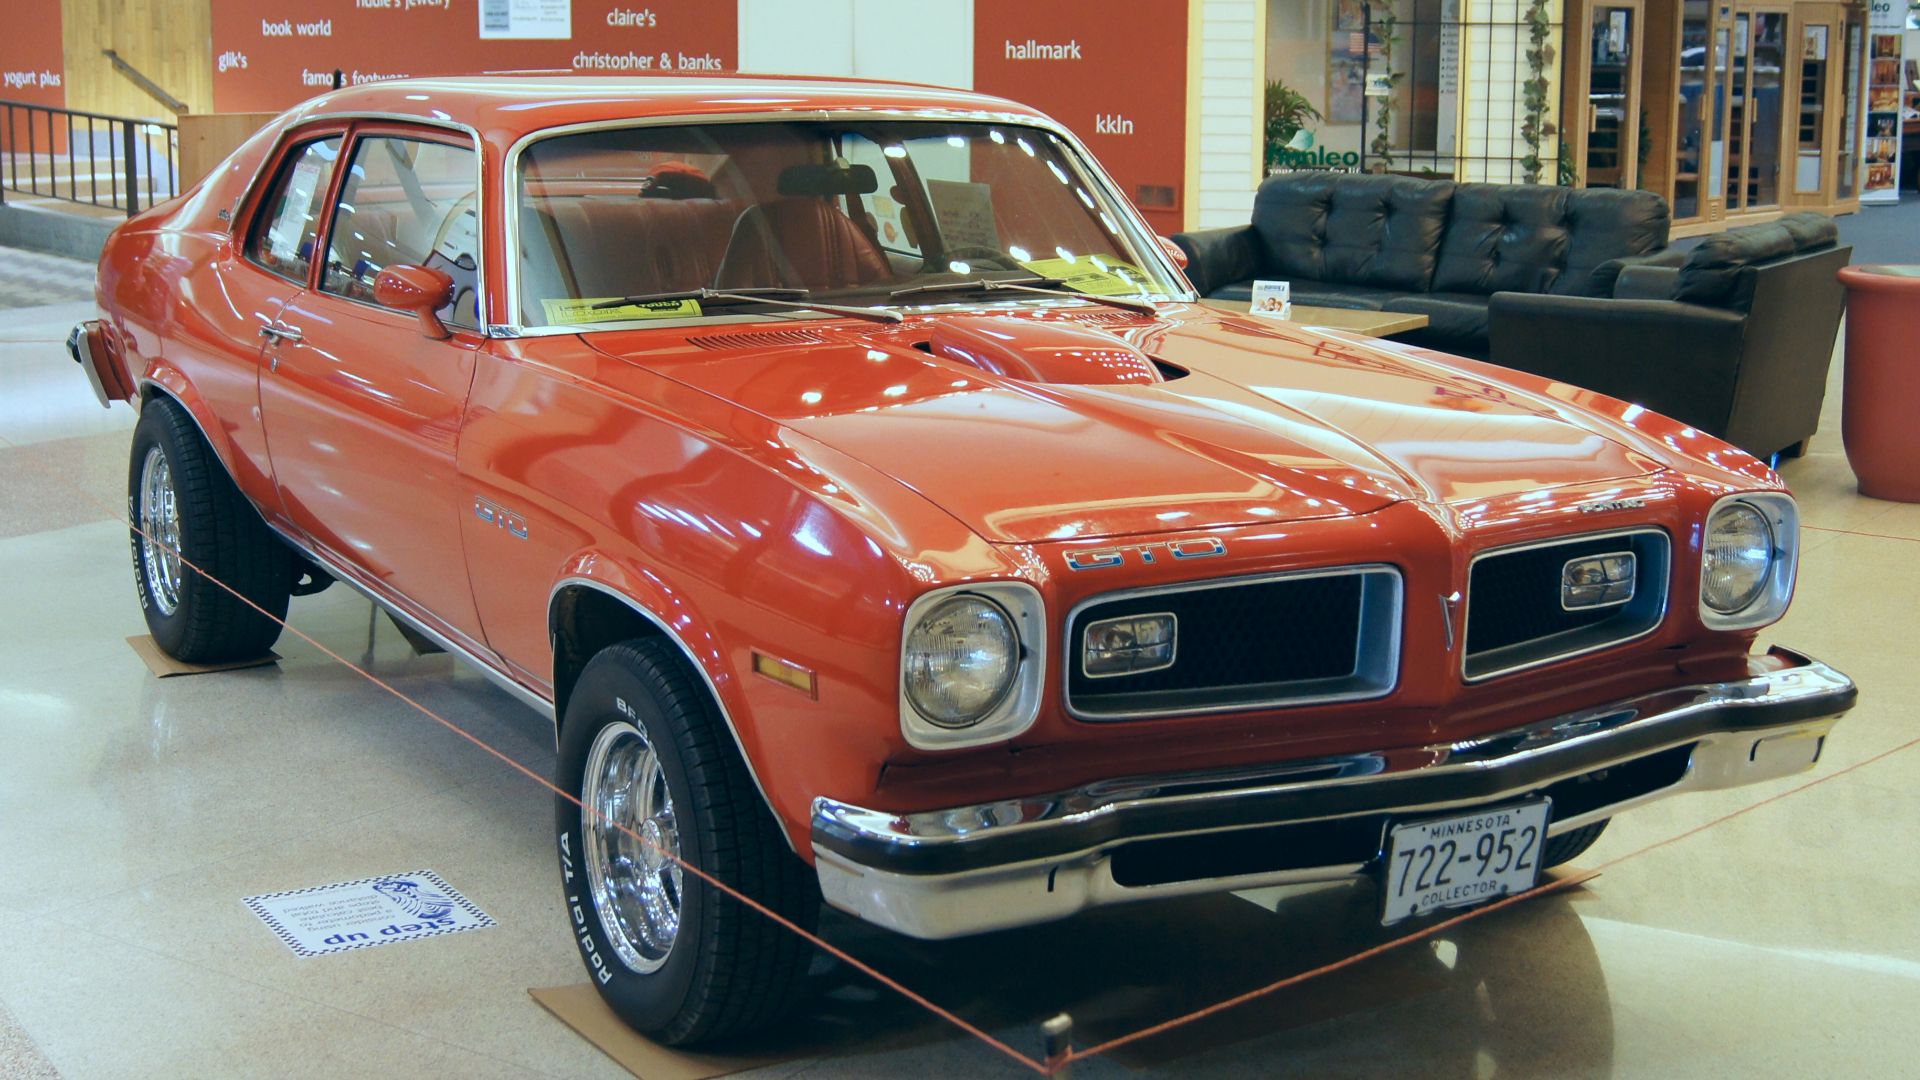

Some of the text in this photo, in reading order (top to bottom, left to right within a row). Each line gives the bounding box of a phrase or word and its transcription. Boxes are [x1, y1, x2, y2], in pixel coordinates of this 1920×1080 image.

[262, 19, 332, 36] book world
[607, 8, 657, 27] claire's
[572, 50, 721, 71] christopher & banks
[1005, 39, 1082, 60] hallmark
[218, 51, 248, 72] glik's
[4, 70, 61, 90] yogurt plus
[302, 69, 347, 86] famos
[1096, 113, 1134, 135] kkln
[474, 495, 529, 541] GTO
[1062, 537, 1228, 572] GTO
[1430, 814, 1510, 839] MINNESOTA
[560, 831, 574, 884] T/A
[1398, 826, 1537, 897] 722-952
[1421, 880, 1498, 907] COLLECTOR
[324, 919, 456, 946] step up
